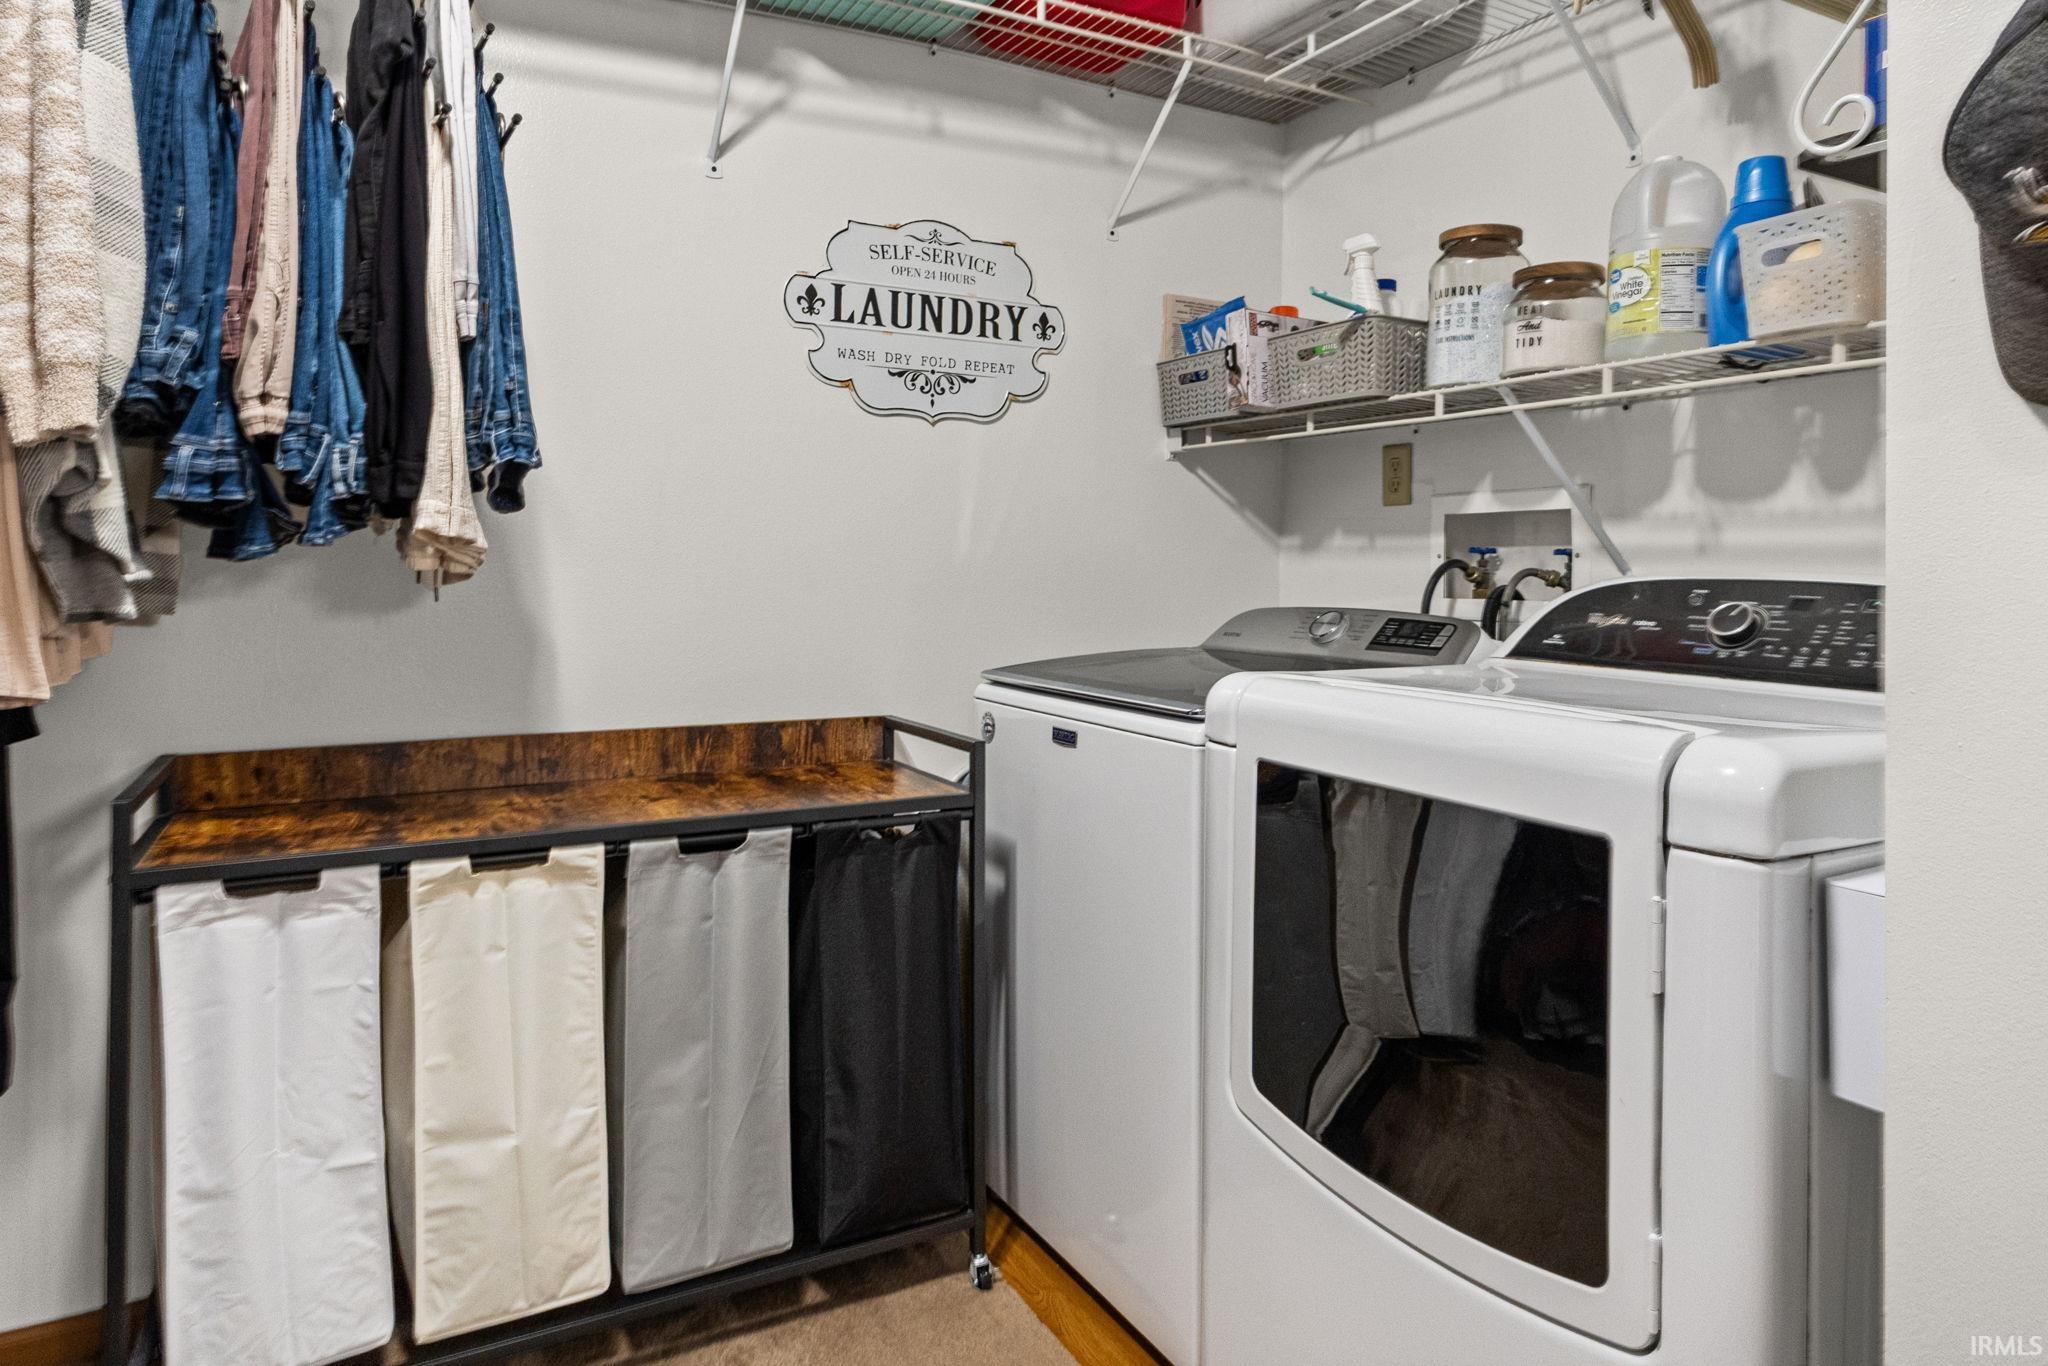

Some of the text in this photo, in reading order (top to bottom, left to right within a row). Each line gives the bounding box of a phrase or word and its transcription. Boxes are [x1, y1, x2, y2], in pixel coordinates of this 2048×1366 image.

[869, 244, 997, 277] SELF-SERVICE
[891, 265, 976, 285] OPEN 24 HOURS
[1434, 284, 1482, 300] LAUNDRY
[1619, 280, 1644, 291] White
[830, 282, 1028, 342] LAUNDRY
[1515, 336, 1543, 349] TIDY
[837, 347, 1015, 375] WASH DRY FOLD REPEAT
